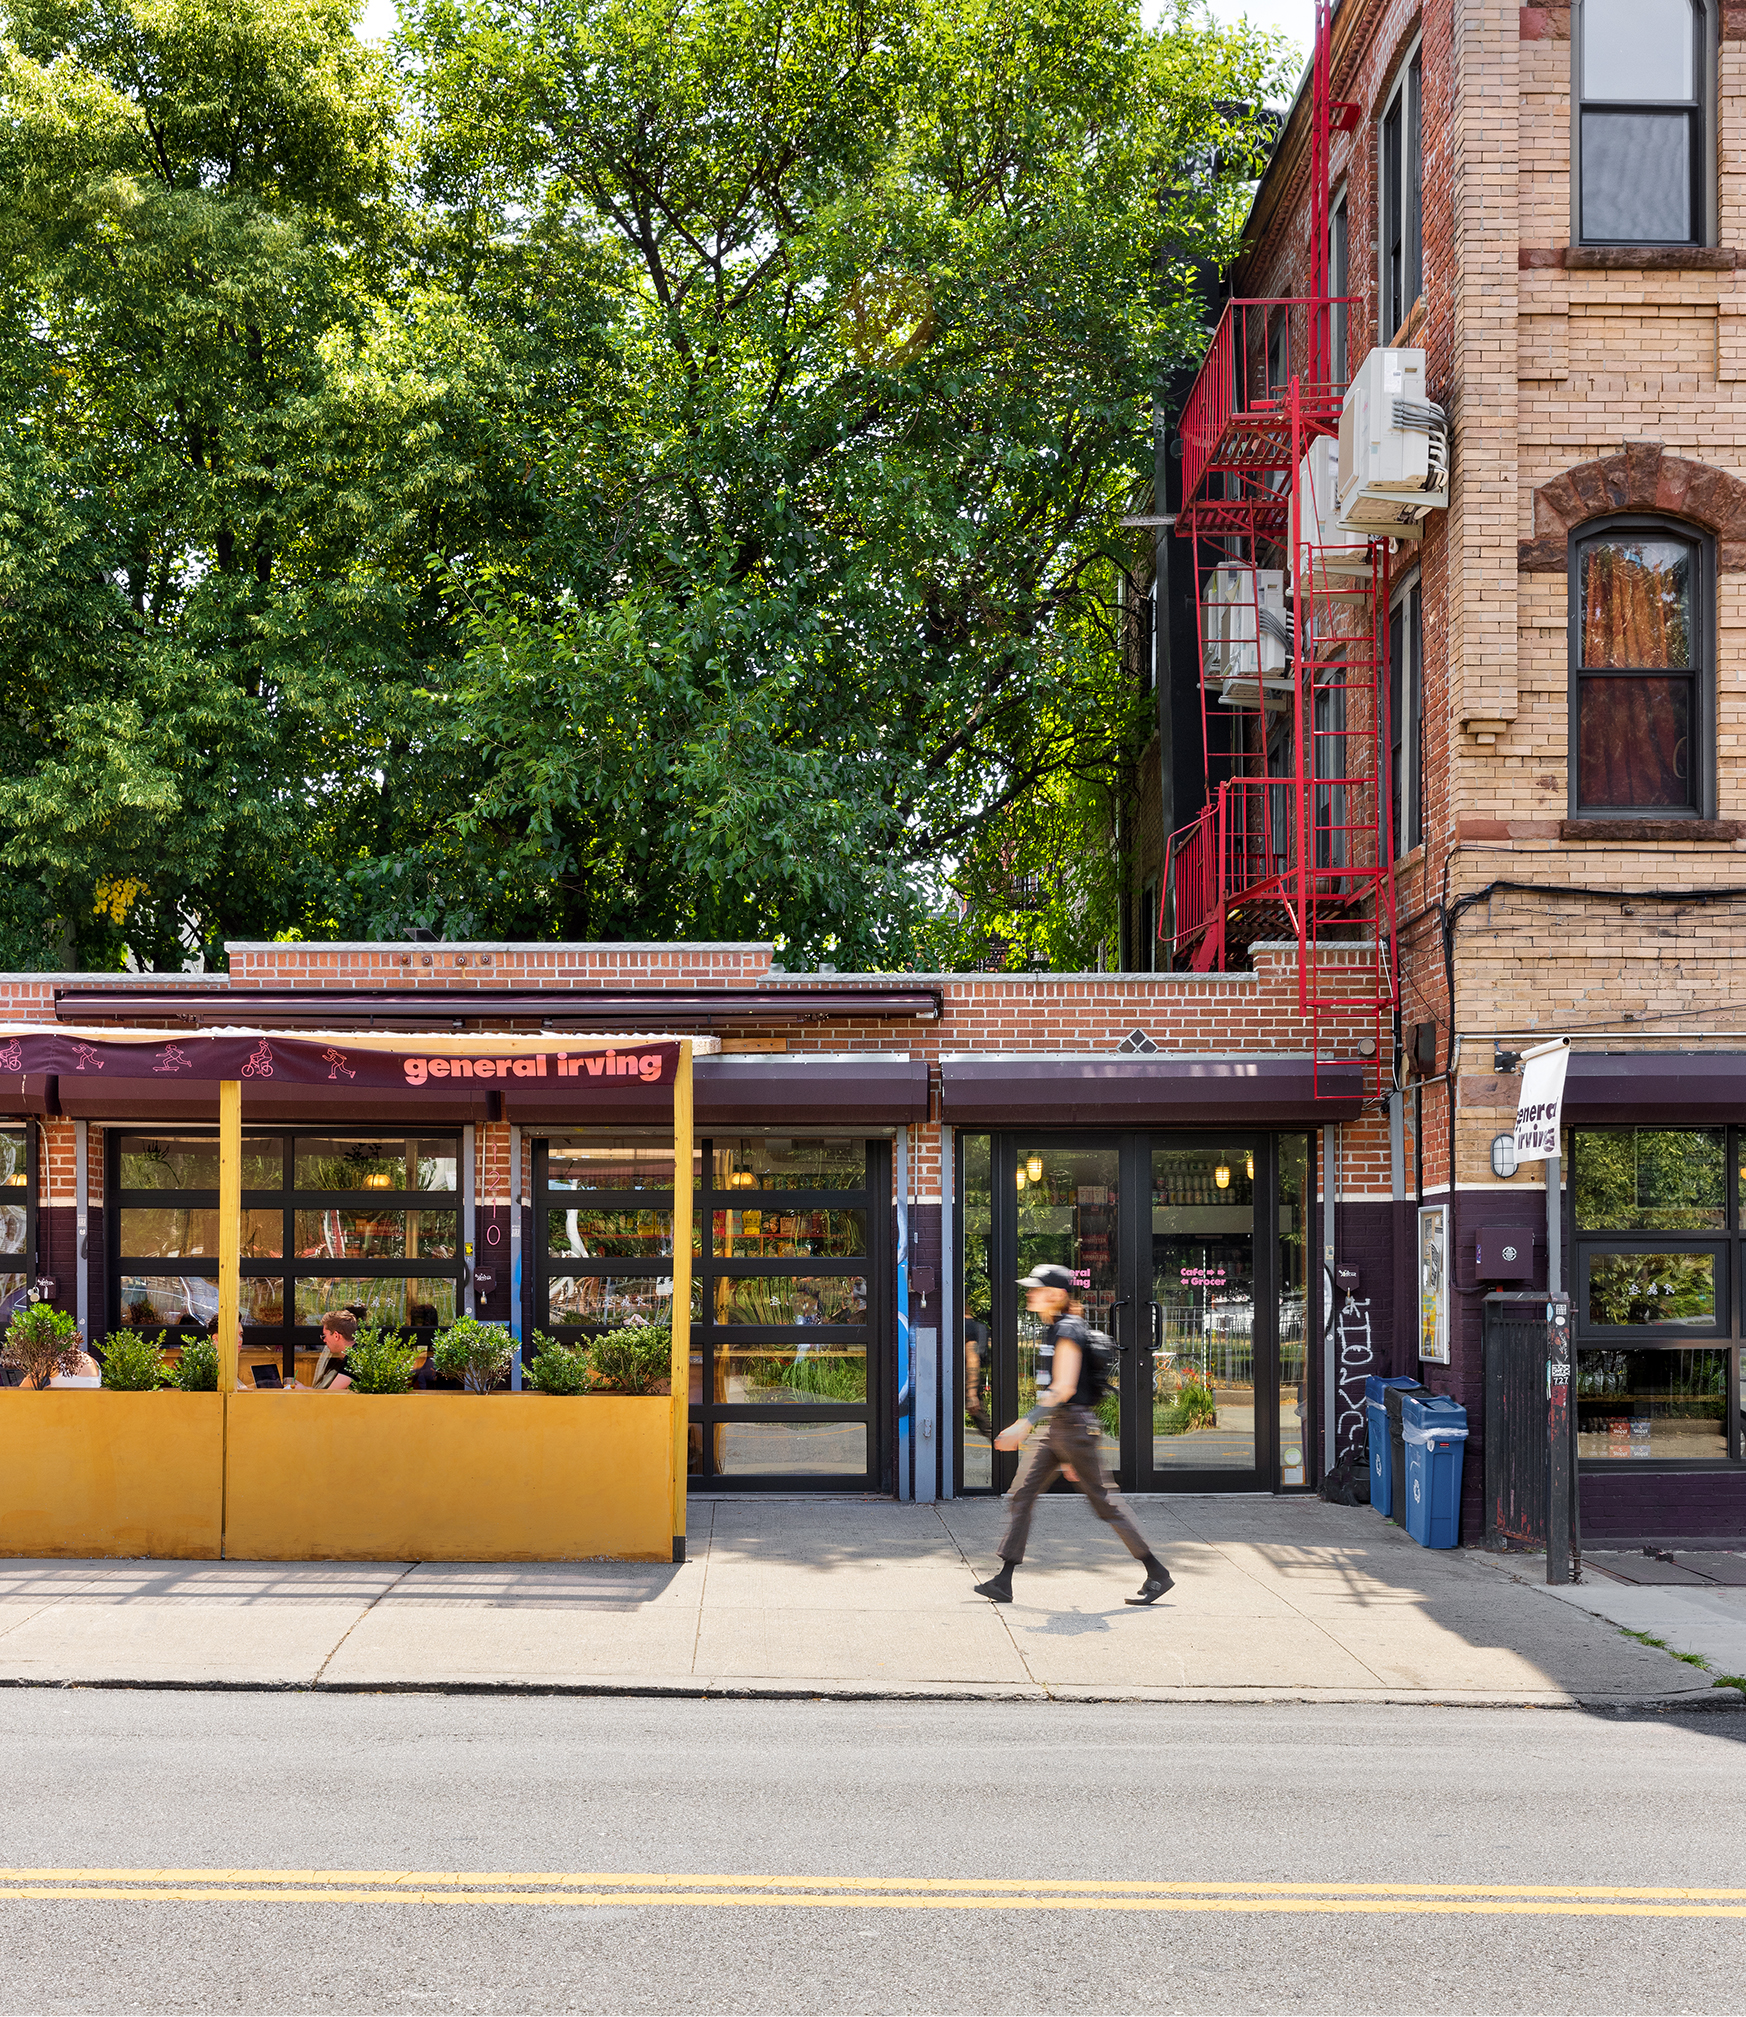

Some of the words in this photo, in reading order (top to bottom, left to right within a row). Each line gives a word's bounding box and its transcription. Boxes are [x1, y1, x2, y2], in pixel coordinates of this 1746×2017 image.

[403, 1054, 547, 1086] general
[556, 1049, 663, 1082] irving
[1515, 1096, 1559, 1132] enera
[1068, 1268, 1091, 1277] eral
[1180, 1267, 1205, 1276] Cafe
[1068, 1277, 1091, 1289] ving
[1190, 1277, 1227, 1286] Grocer
